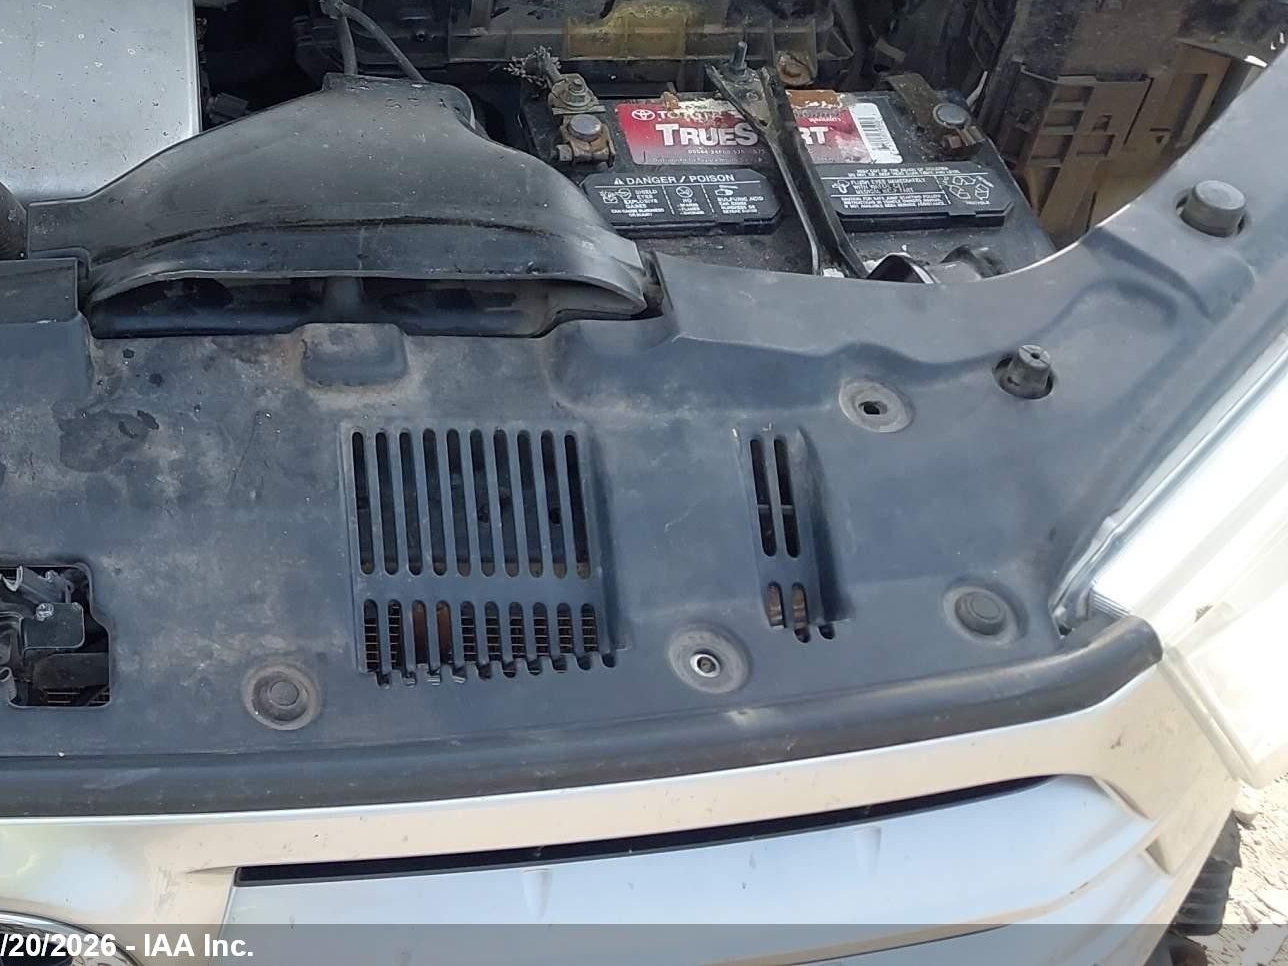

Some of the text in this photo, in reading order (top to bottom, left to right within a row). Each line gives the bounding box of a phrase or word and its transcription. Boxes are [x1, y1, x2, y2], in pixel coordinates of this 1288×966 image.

[655, 122, 829, 146] TRUESRT
[626, 176, 677, 185] DANGER
[688, 174, 735, 183] POISON
